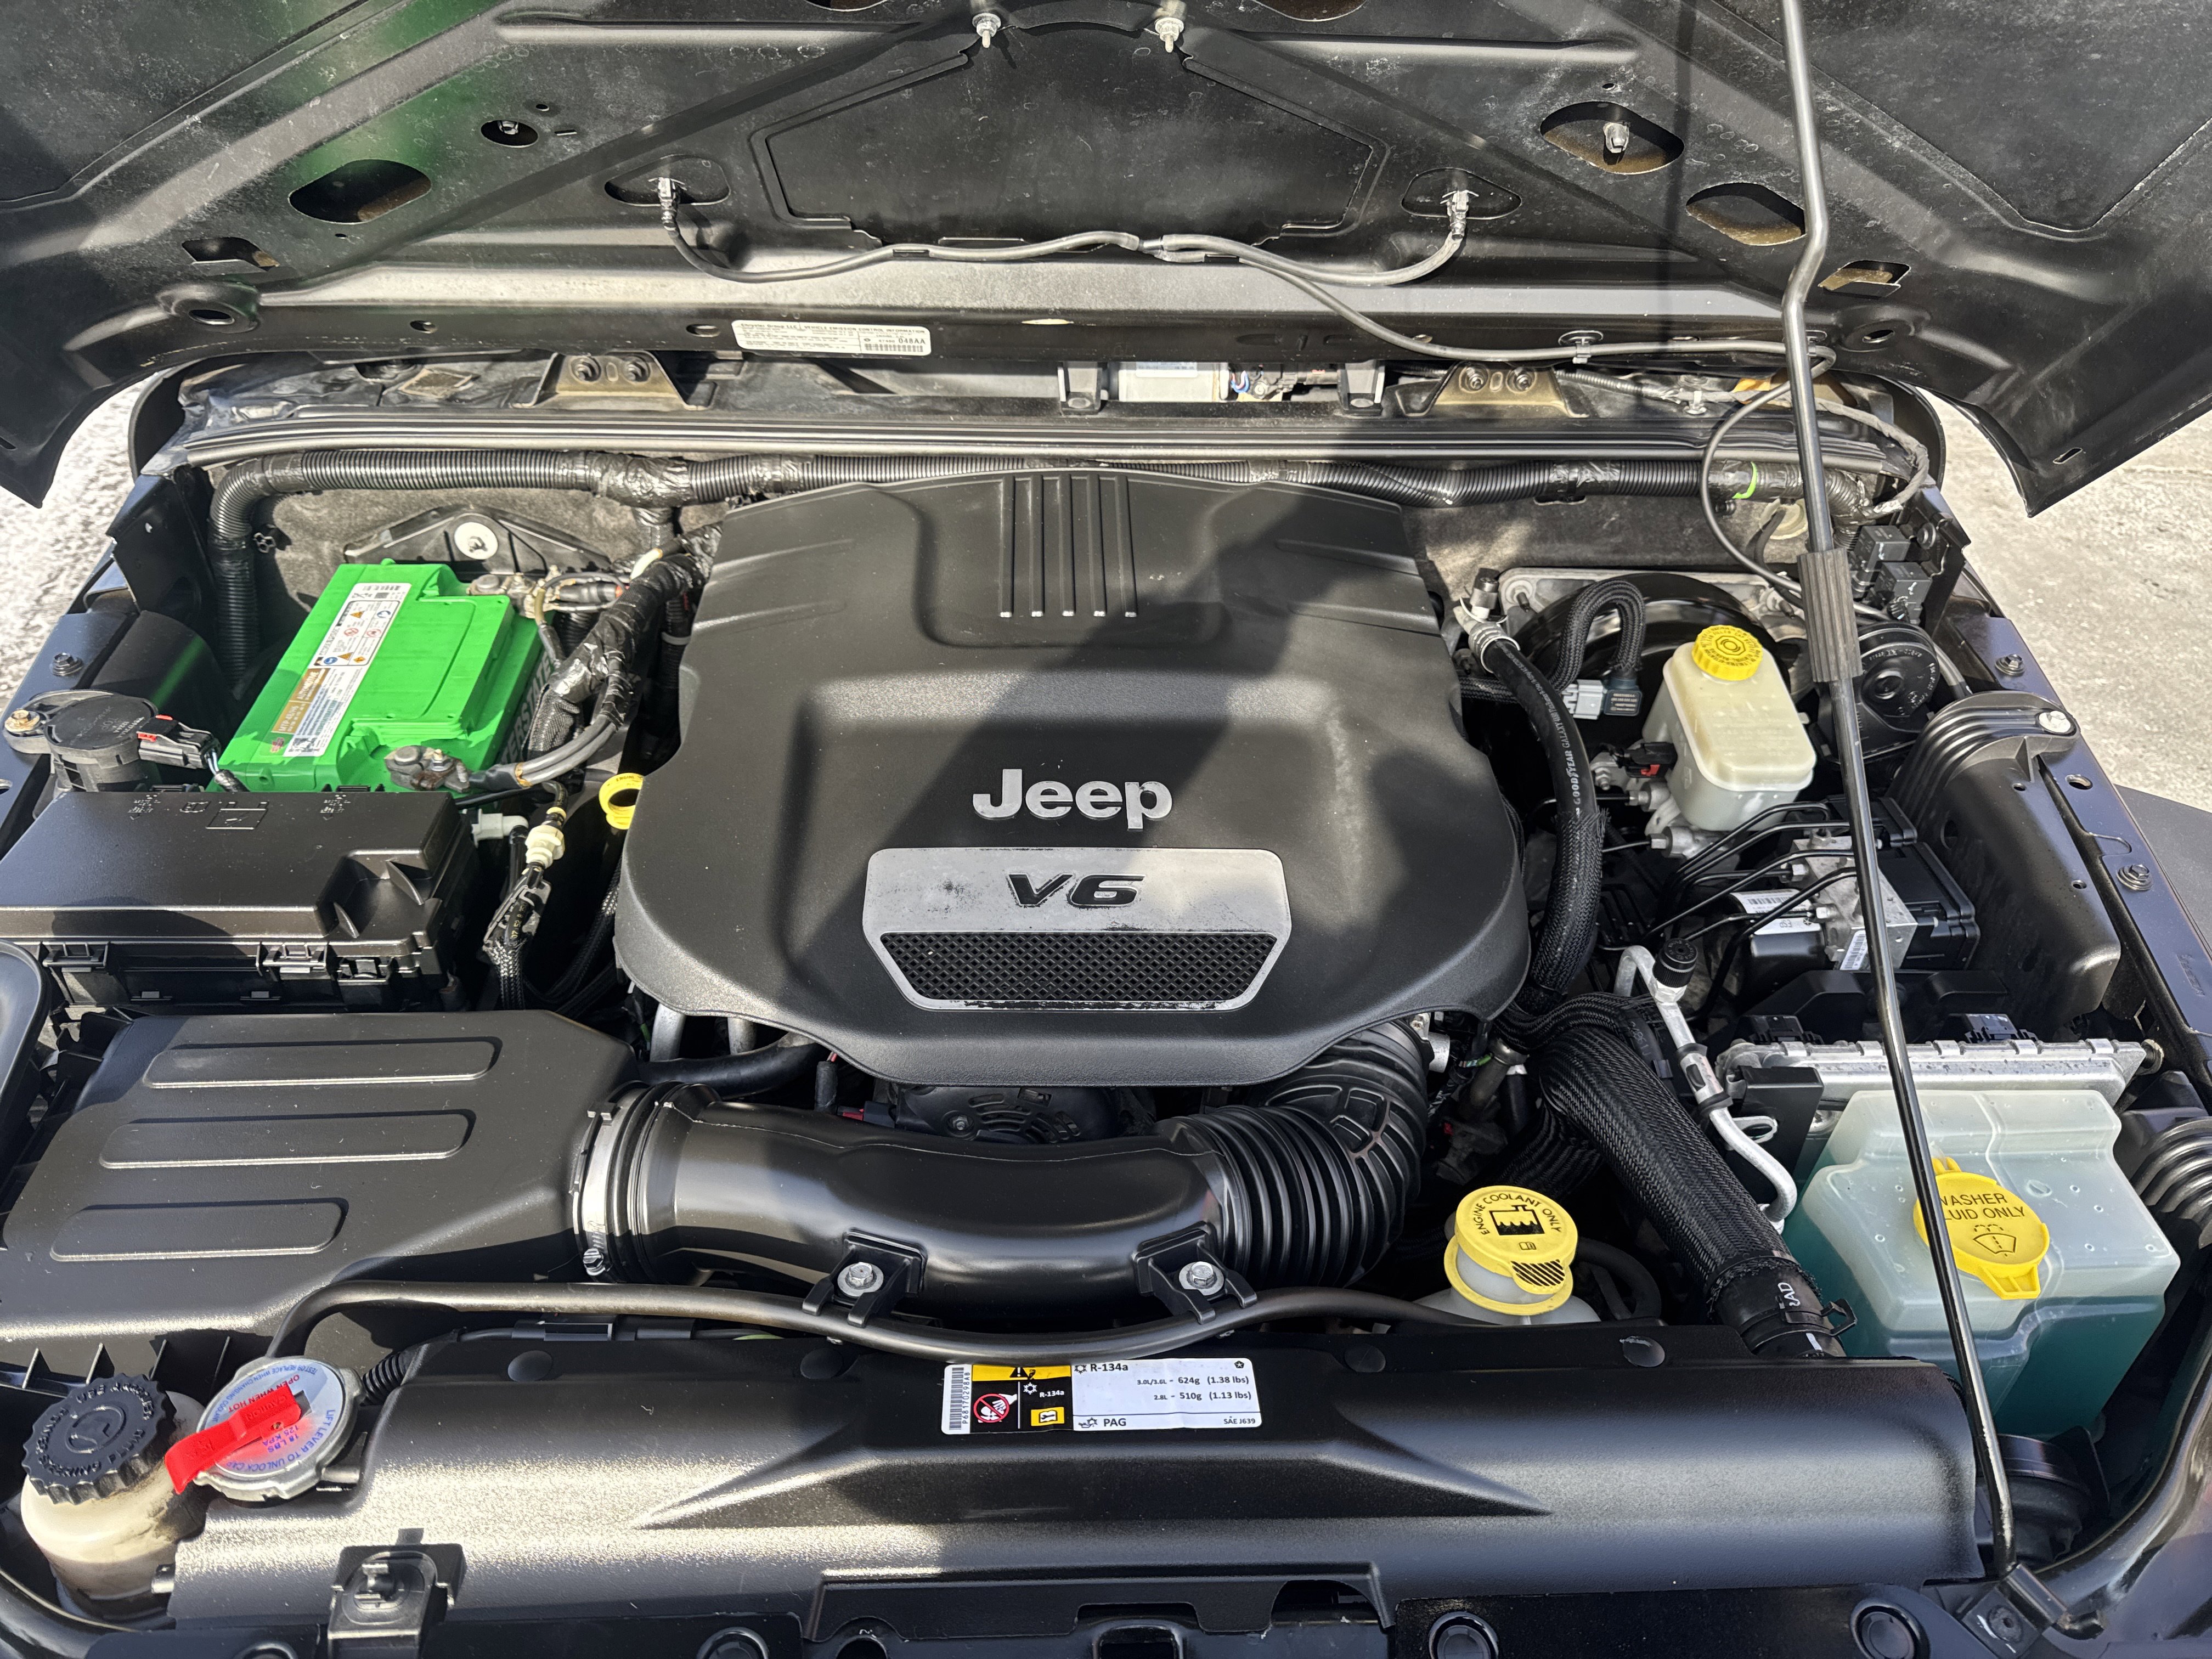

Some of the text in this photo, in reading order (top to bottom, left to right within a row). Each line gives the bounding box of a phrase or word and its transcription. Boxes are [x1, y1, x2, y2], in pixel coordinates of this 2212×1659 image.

[500, 651, 551, 765] TERSTATE
[1555, 722, 1570, 748] GALAXY
[1564, 750, 1581, 805] GOODYEAR
[973, 769, 1173, 831] Jeep
[1008, 873, 1146, 908] V6
[1779, 919, 1793, 928] ESP
[1472, 1193, 1562, 1235] ENGINE COOLANT ONLY
[1945, 1206, 2025, 1221] UID ONLY
[253, 1370, 271, 1381] WHEN
[272, 1364, 297, 1375] REPLACE
[306, 1365, 318, 1375] TEST
[1090, 1363, 1129, 1373] R-134a
[275, 1374, 300, 1390] OPEN
[1178, 1376, 1200, 1385] 624g
[1207, 1376, 1231, 1385] (1.38
[1232, 1376, 1249, 1384] lbs)
[226, 1379, 253, 1401] CHANGING
[1039, 1390, 1065, 1398] R-134a
[1180, 1392, 1202, 1401] 510g
[1209, 1391, 1232, 1401] (1.13
[1234, 1391, 1251, 1400] lbs)
[228, 1400, 248, 1413] HOT
[962, 1372, 970, 1425] P68170298AB
[211, 1399, 229, 1423] COOLANT
[1103, 1418, 1126, 1427] PAG
[226, 1409, 336, 1472] LIFT LEVER TO UNLOCK CAP
[262, 1425, 300, 1446] 125 KPA
[107, 1429, 145, 1464] FLUID
[267, 1440, 287, 1453] LBS
